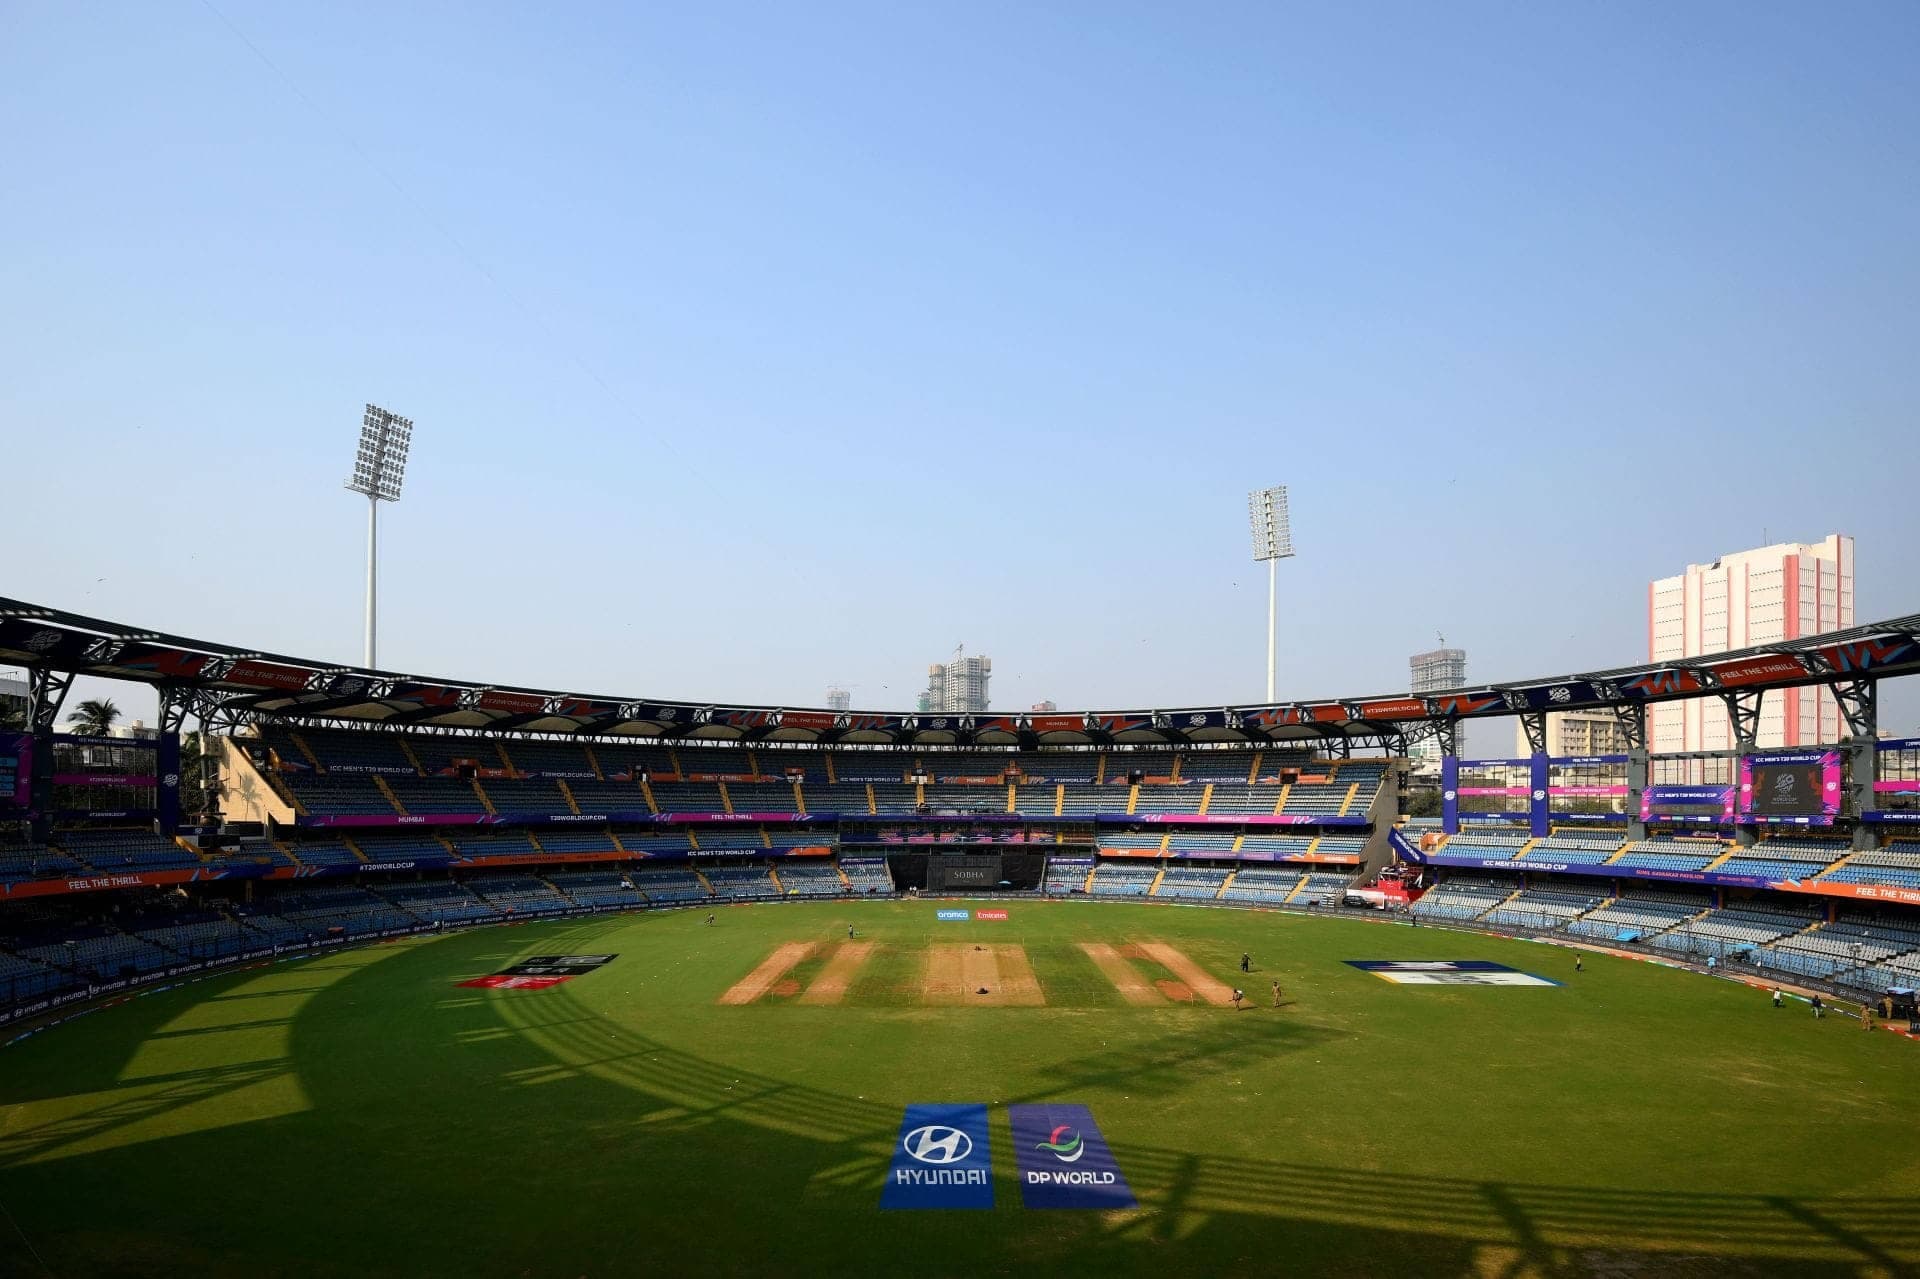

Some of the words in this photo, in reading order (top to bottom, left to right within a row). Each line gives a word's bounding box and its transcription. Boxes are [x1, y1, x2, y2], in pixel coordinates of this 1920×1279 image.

[256, 671, 274, 680] THE
[1720, 670, 1743, 679] FEEL
[1742, 667, 1763, 676] THE
[1762, 663, 1798, 673] THRILL
[360, 862, 415, 871] #T20WORLDCUP
[953, 871, 984, 879] SOBHA
[68, 880, 91, 889] FEEL
[92, 878, 110, 887] THE
[111, 876, 142, 886] THRILL
[1855, 887, 1877, 897] FEEL
[1880, 889, 1897, 898] THE
[977, 911, 1007, 919] Emirates
[896, 1169, 986, 1185] HYUNDAI
[1027, 1171, 1051, 1185] DP
[1055, 1171, 1115, 1185] WORLD
